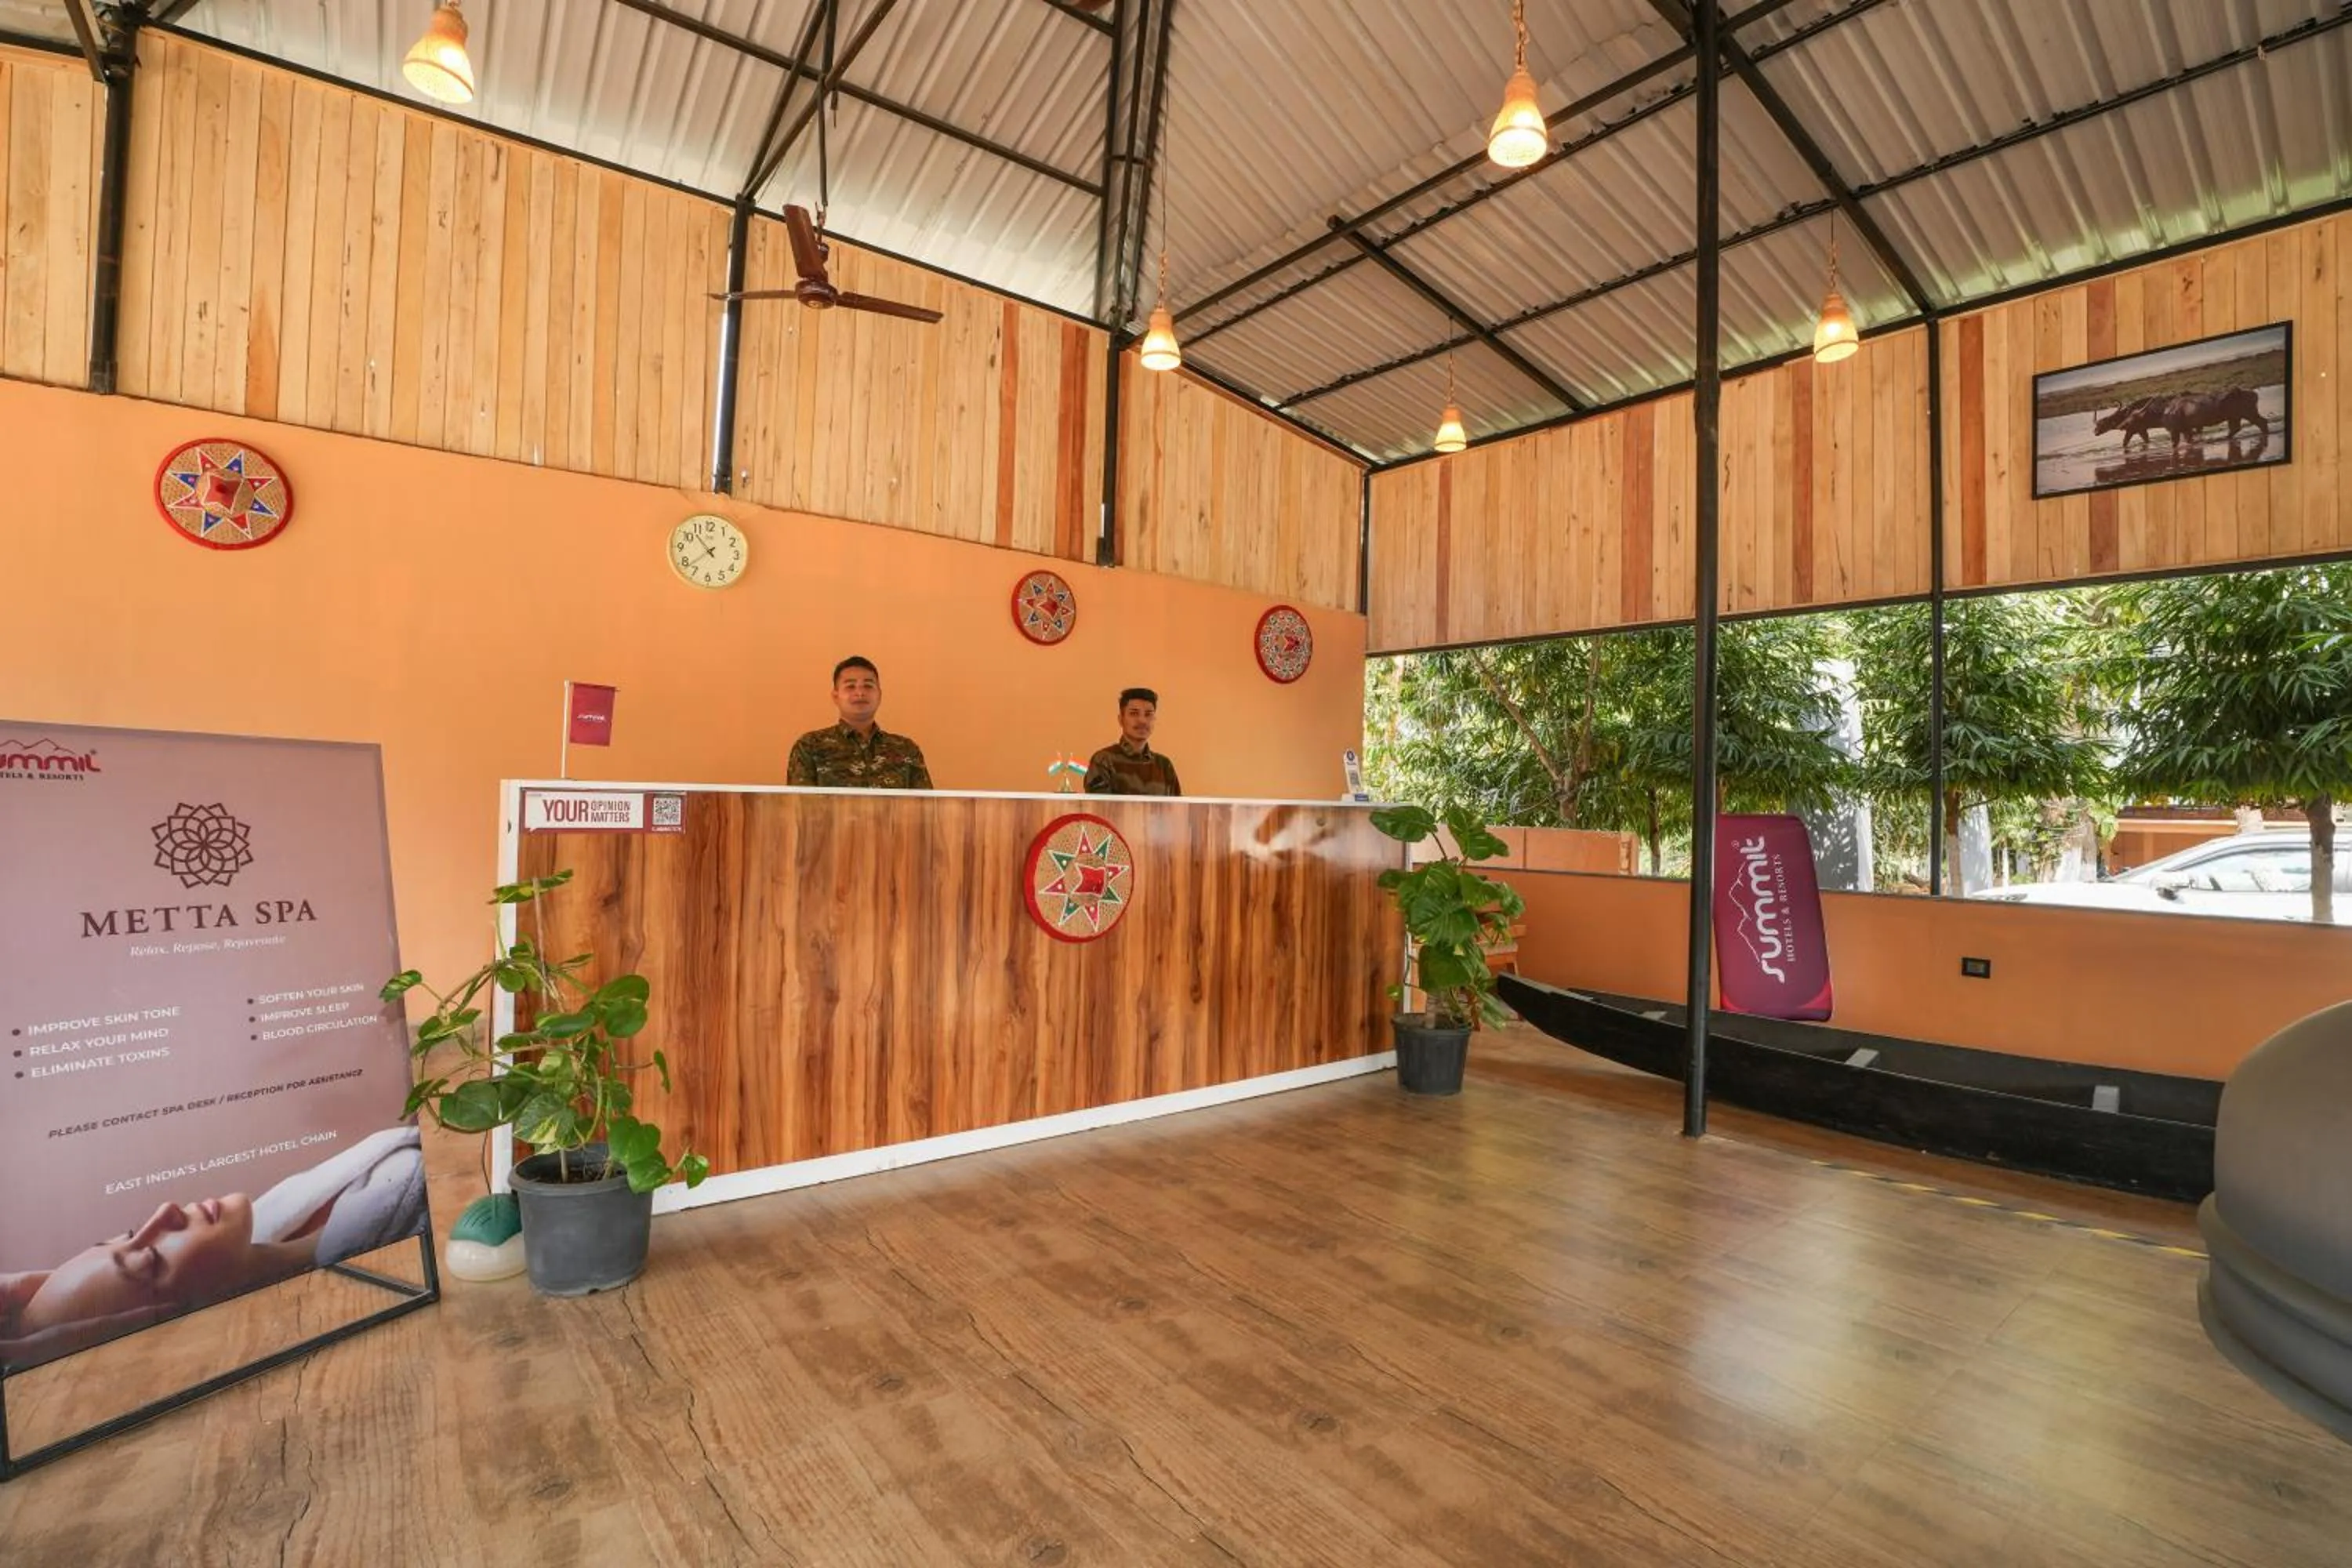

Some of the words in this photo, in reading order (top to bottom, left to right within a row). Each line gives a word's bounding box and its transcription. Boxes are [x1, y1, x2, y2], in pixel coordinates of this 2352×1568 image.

[693, 523, 702, 535] 11
[706, 521, 716, 532] 12
[720, 526, 727, 537] 1
[683, 531, 694, 543] 10
[728, 537, 736, 548] 2
[677, 542, 684, 553] 9
[681, 556, 689, 567] 8
[733, 550, 740, 561] 3
[691, 565, 699, 576] 7
[728, 563, 735, 572] 4
[704, 572, 711, 583] 6
[717, 570, 725, 581] 5
[0, 753, 101, 772] mmit
[543, 799, 589, 822] YOUR
[590, 800, 630, 811] OPINION
[590, 811, 630, 822] MATTERS
[1772, 853, 1788, 902] RESORTS
[1739, 836, 1786, 984] summit
[1780, 906, 1791, 915] &
[80, 903, 238, 939] METTA
[254, 898, 318, 925] SPA
[1781, 919, 1796, 963] HOTELS
[259, 990, 304, 1004] SOFTEN
[307, 986, 337, 998] YOUR
[339, 982, 365, 993] SKIN
[261, 1007, 313, 1022] IMPROVE
[316, 1002, 350, 1014] SLEEP
[28, 1017, 101, 1036] IMPROVE
[104, 1012, 139, 1025] SKIN
[141, 1006, 182, 1021] TONE
[263, 1026, 304, 1040] BLOOD
[307, 1015, 378, 1033] CIRCULATION
[29, 1040, 81, 1057] RELAX
[85, 1034, 126, 1048] YOUR
[131, 1028, 169, 1042] MIND
[31, 1056, 116, 1078] ELIMINATE
[118, 1047, 171, 1064] TOXINS
[48, 1121, 98, 1138] PLEASE
[102, 1109, 159, 1128] CONTACT
[162, 1104, 184, 1116] SPA
[187, 1097, 216, 1110] DESK
[227, 1085, 284, 1102] RECEPTION
[286, 1080, 307, 1091] FOR
[308, 1069, 364, 1086] ASSISTANCE
[105, 1178, 142, 1195] EAST
[146, 1164, 198, 1185] INDIA'S
[200, 1149, 257, 1171] LARGEST
[259, 1139, 299, 1156] HOTEL
[300, 1130, 337, 1146] CHAIN
